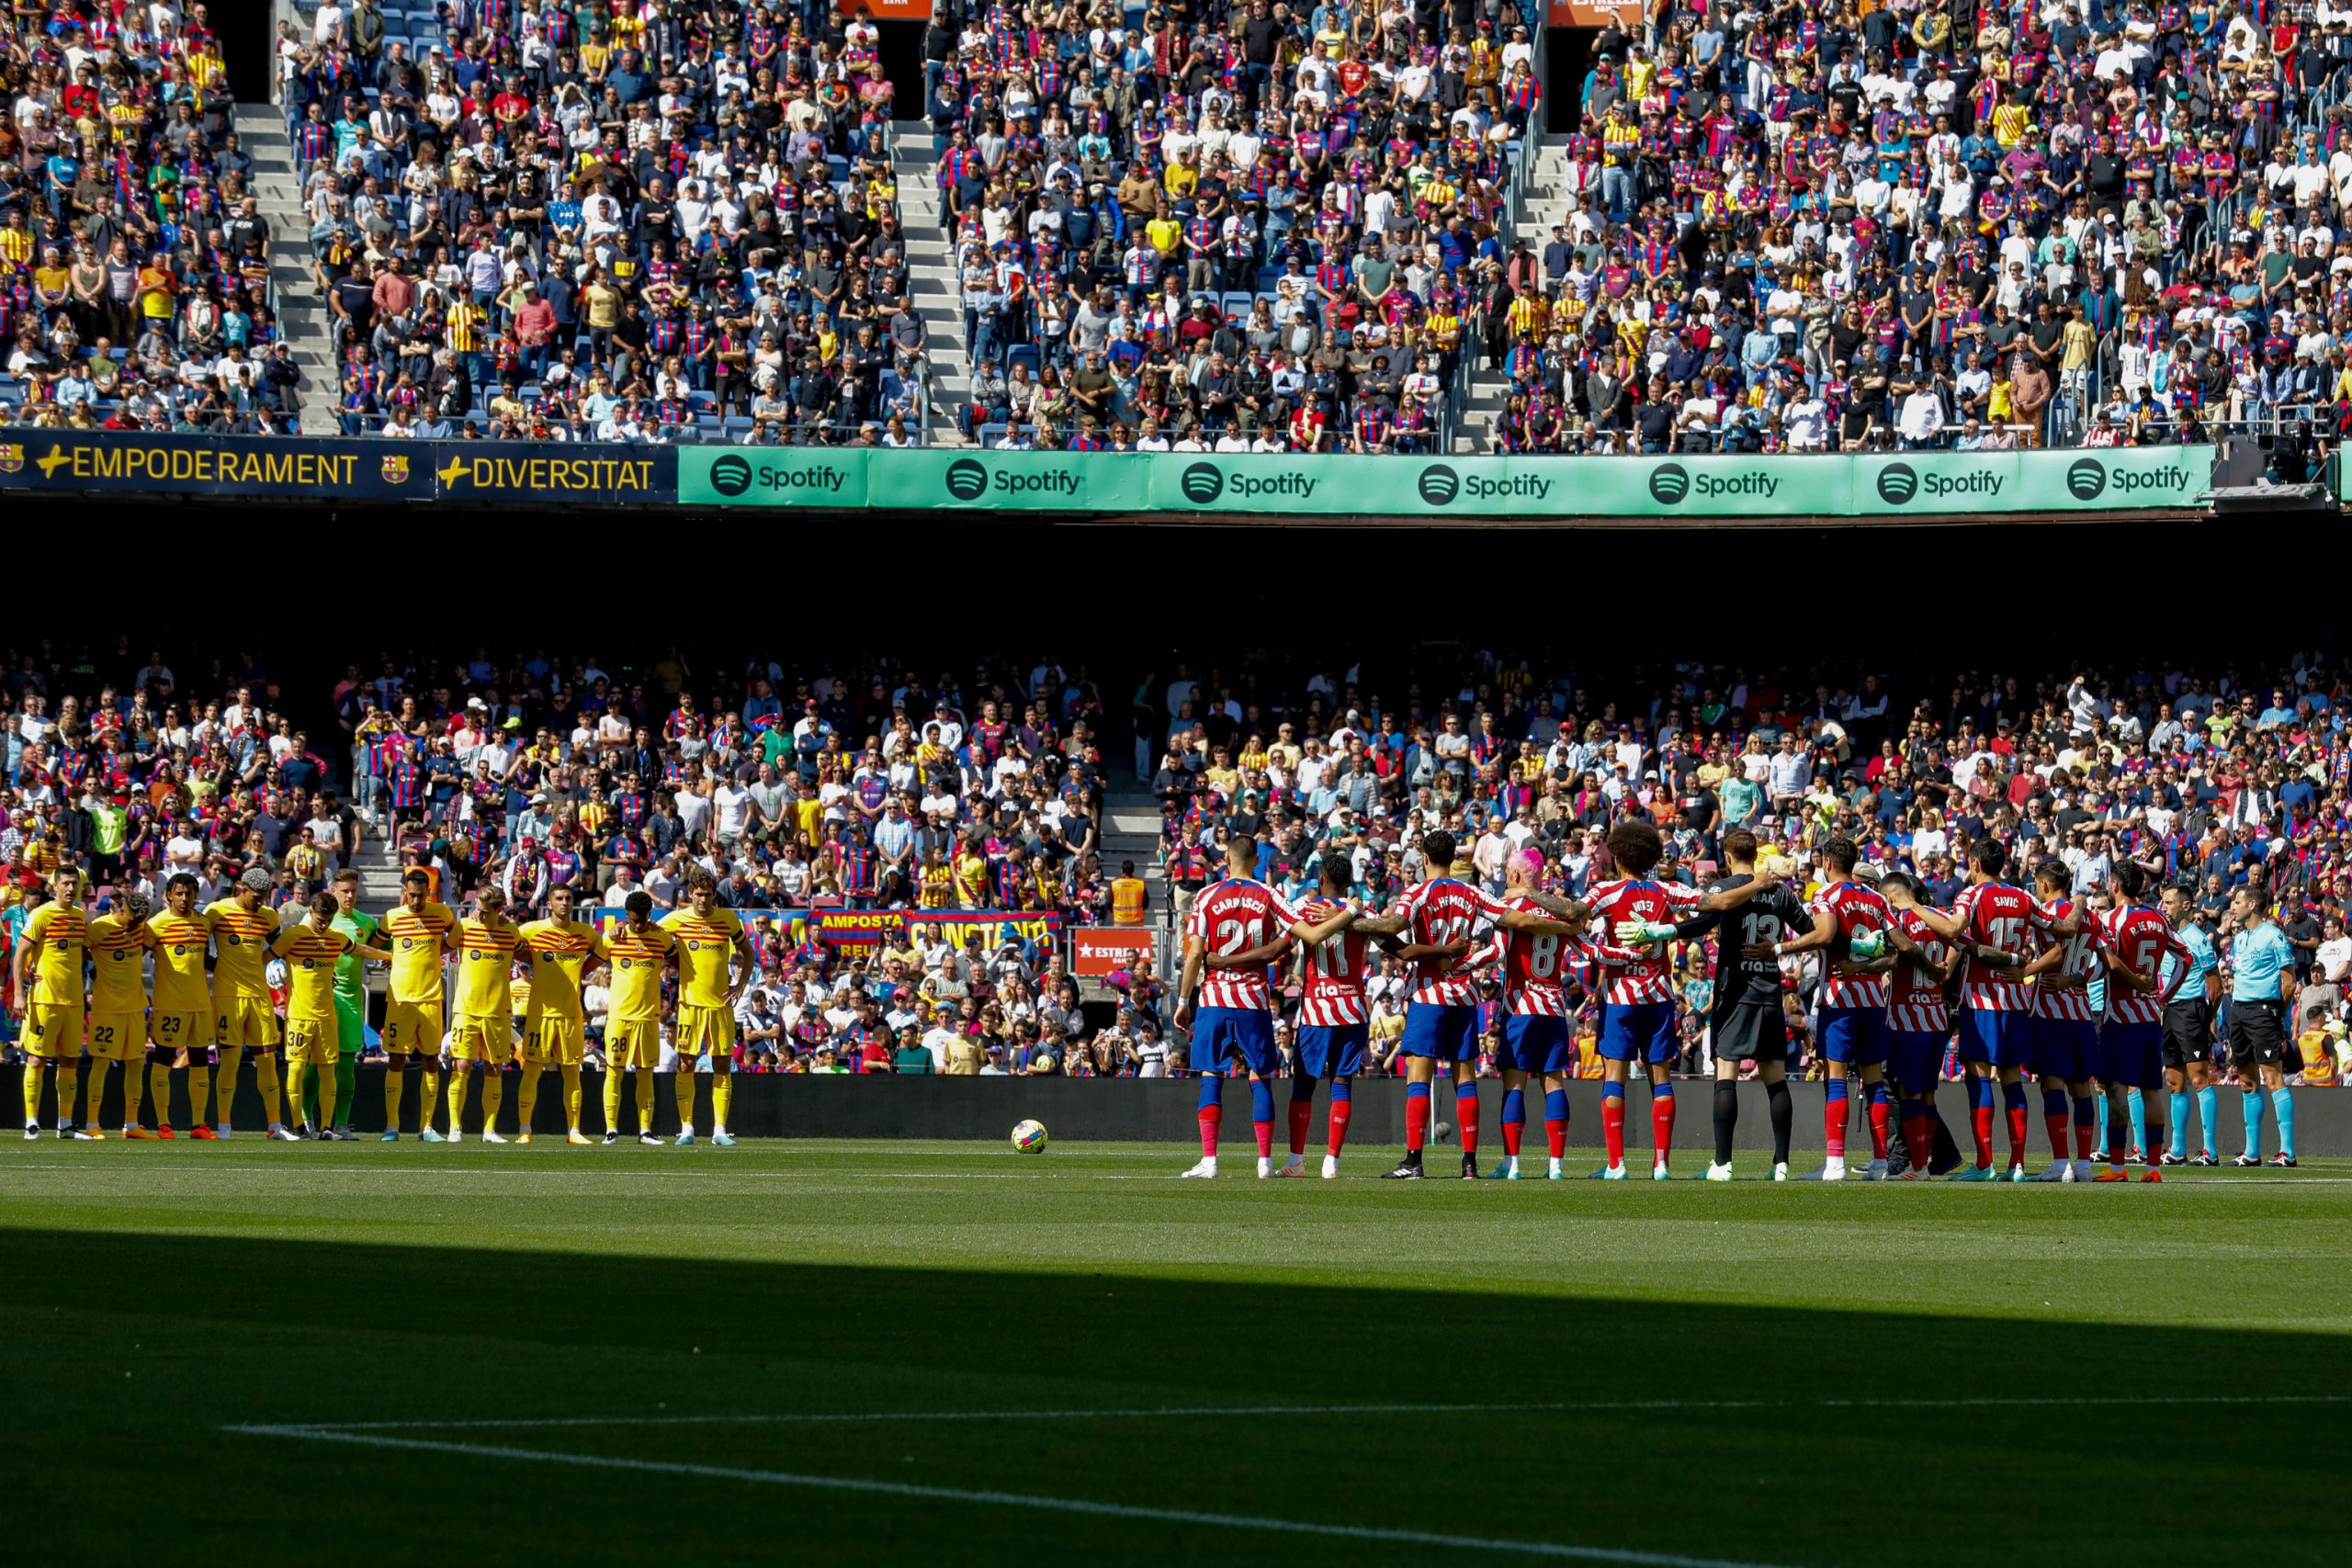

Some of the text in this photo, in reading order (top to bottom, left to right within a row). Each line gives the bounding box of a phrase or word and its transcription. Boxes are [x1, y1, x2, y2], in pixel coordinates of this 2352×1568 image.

[758, 465, 846, 491] Spotify
[994, 468, 1080, 495] Spotify
[1229, 472, 1317, 498] Spotify
[1695, 471, 1781, 498] Spotify
[1924, 469, 2005, 497] Spotify
[2112, 466, 2190, 493] Spotify
[1464, 474, 1551, 500] Spotify
[822, 914, 903, 928] AMPOSTA
[413, 939, 436, 947] Spotify
[1217, 919, 1263, 957] 21
[1987, 917, 2025, 953] 15
[701, 942, 723, 951] Spotify
[840, 944, 871, 957] REU
[1531, 931, 1558, 978] 8
[2061, 932, 2093, 976] 16
[2136, 940, 2157, 979] 5
[1315, 981, 1339, 998] ria
[36, 1024, 44, 1041] 9
[162, 1016, 181, 1032] 23
[219, 1016, 228, 1032] 4
[389, 1022, 397, 1038] 5
[678, 1024, 691, 1039] 17
[95, 1026, 114, 1043] 22
[288, 1031, 303, 1047] 30
[453, 1026, 463, 1043] 21
[528, 1032, 540, 1048] 11
[611, 1037, 627, 1053] 28
